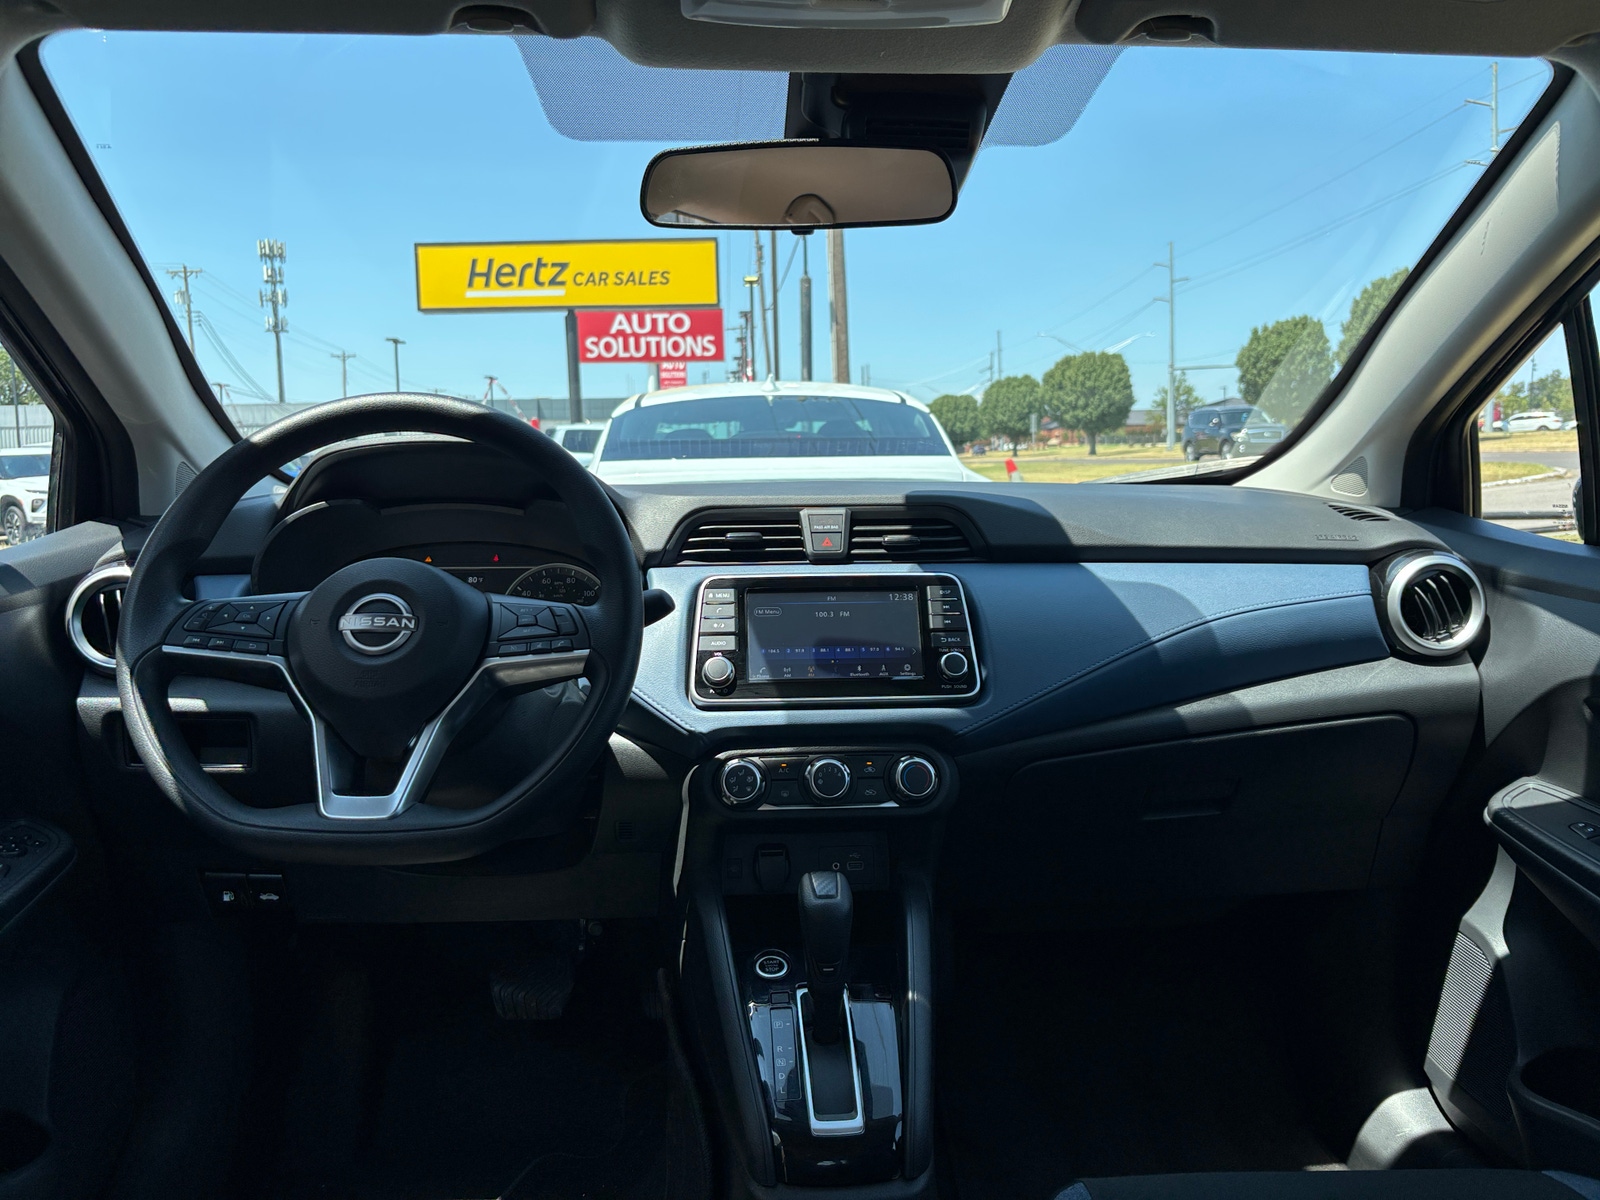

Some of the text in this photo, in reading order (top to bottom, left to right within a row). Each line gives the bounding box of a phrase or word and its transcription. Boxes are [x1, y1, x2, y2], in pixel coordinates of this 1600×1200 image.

[467, 257, 671, 288] Hertz CAR SALES
[609, 312, 691, 334] AUTO
[585, 335, 717, 359] SOLUTIONS
[888, 593, 914, 601] 12:38
[340, 616, 415, 628] NISSAN
[777, 1045, 783, 1053] R
[778, 1072, 786, 1080] D
[780, 1086, 786, 1094] L
